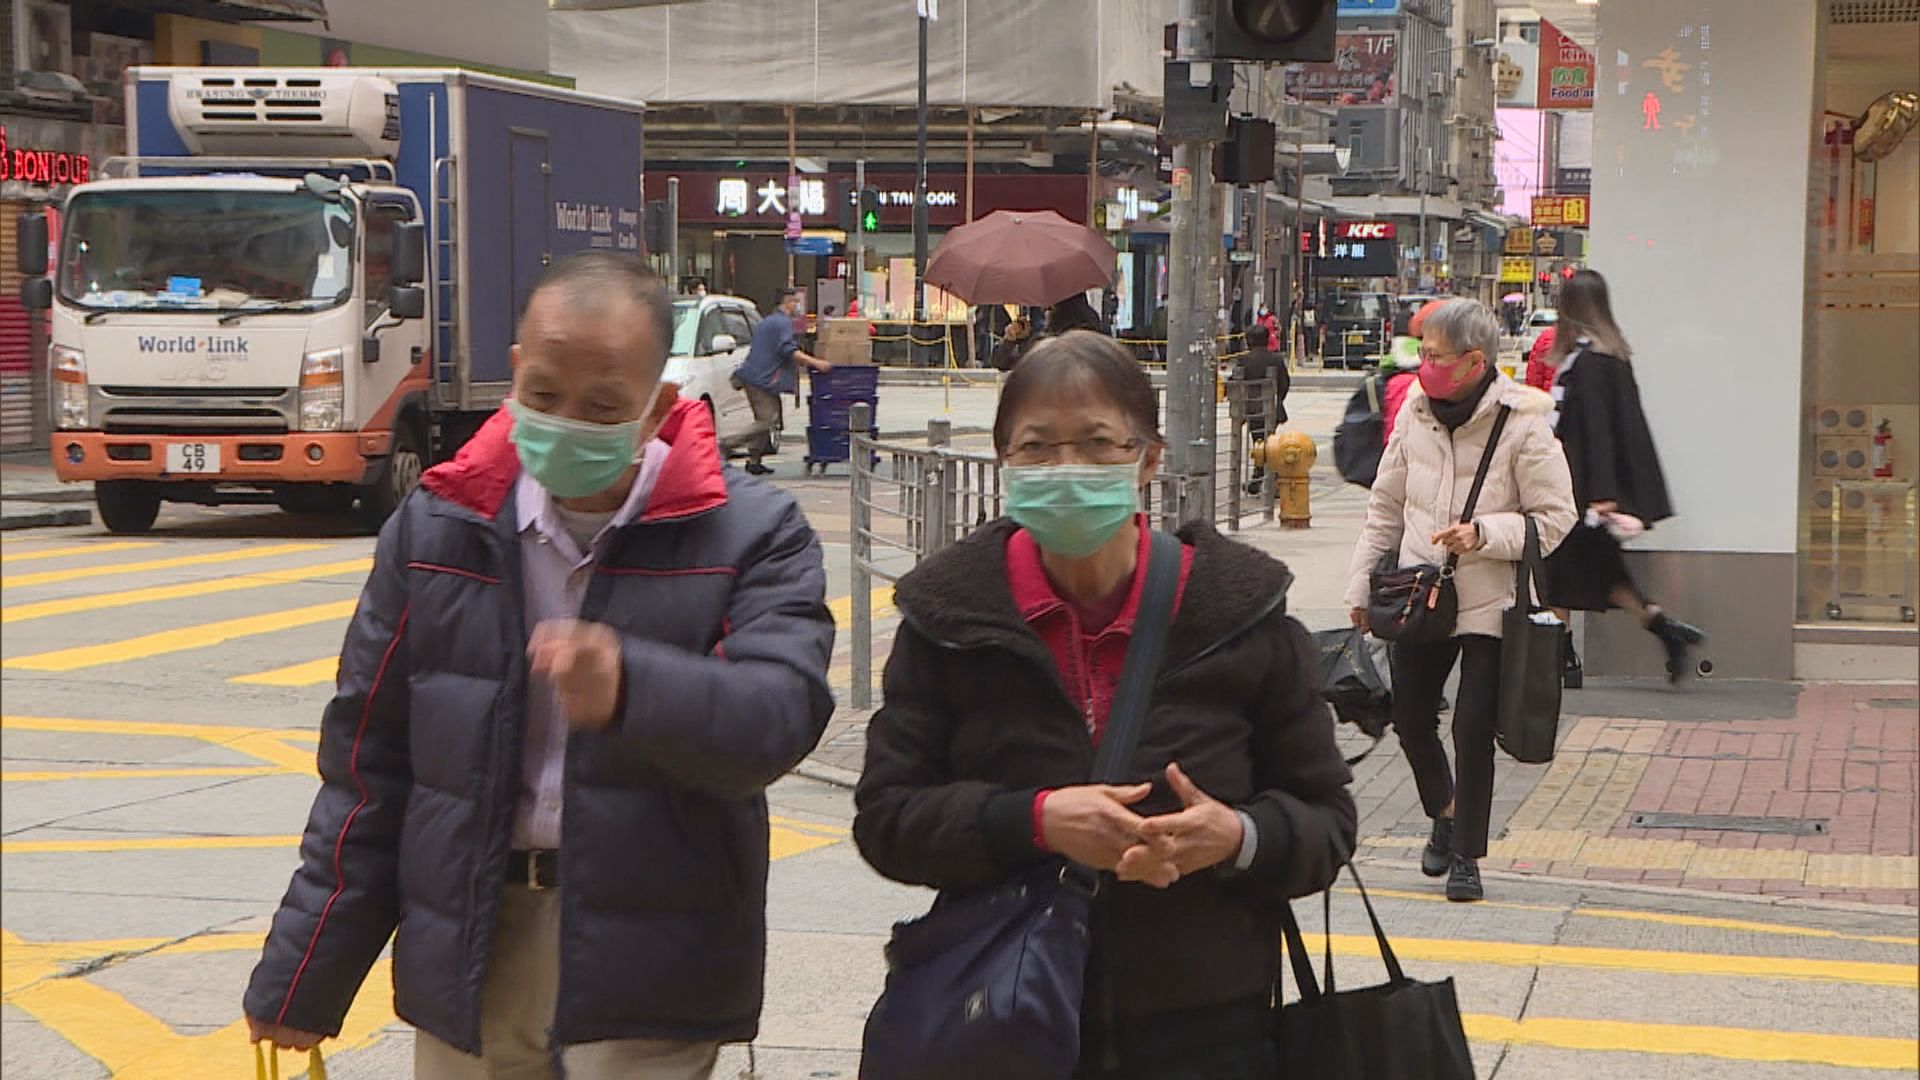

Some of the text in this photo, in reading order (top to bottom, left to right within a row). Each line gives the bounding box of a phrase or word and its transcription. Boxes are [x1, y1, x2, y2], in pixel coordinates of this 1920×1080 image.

[1365, 36, 1393, 55] 1/F
[275, 90, 326, 99] THERMO
[1550, 87, 1580, 99] Food
[14, 149, 89, 188] BONJOUR
[555, 202, 587, 231] World
[590, 205, 612, 233] link
[1346, 223, 1386, 238] KFC
[138, 336, 249, 353] World link
[182, 443, 206, 457] CB
[182, 457, 206, 471] 49
